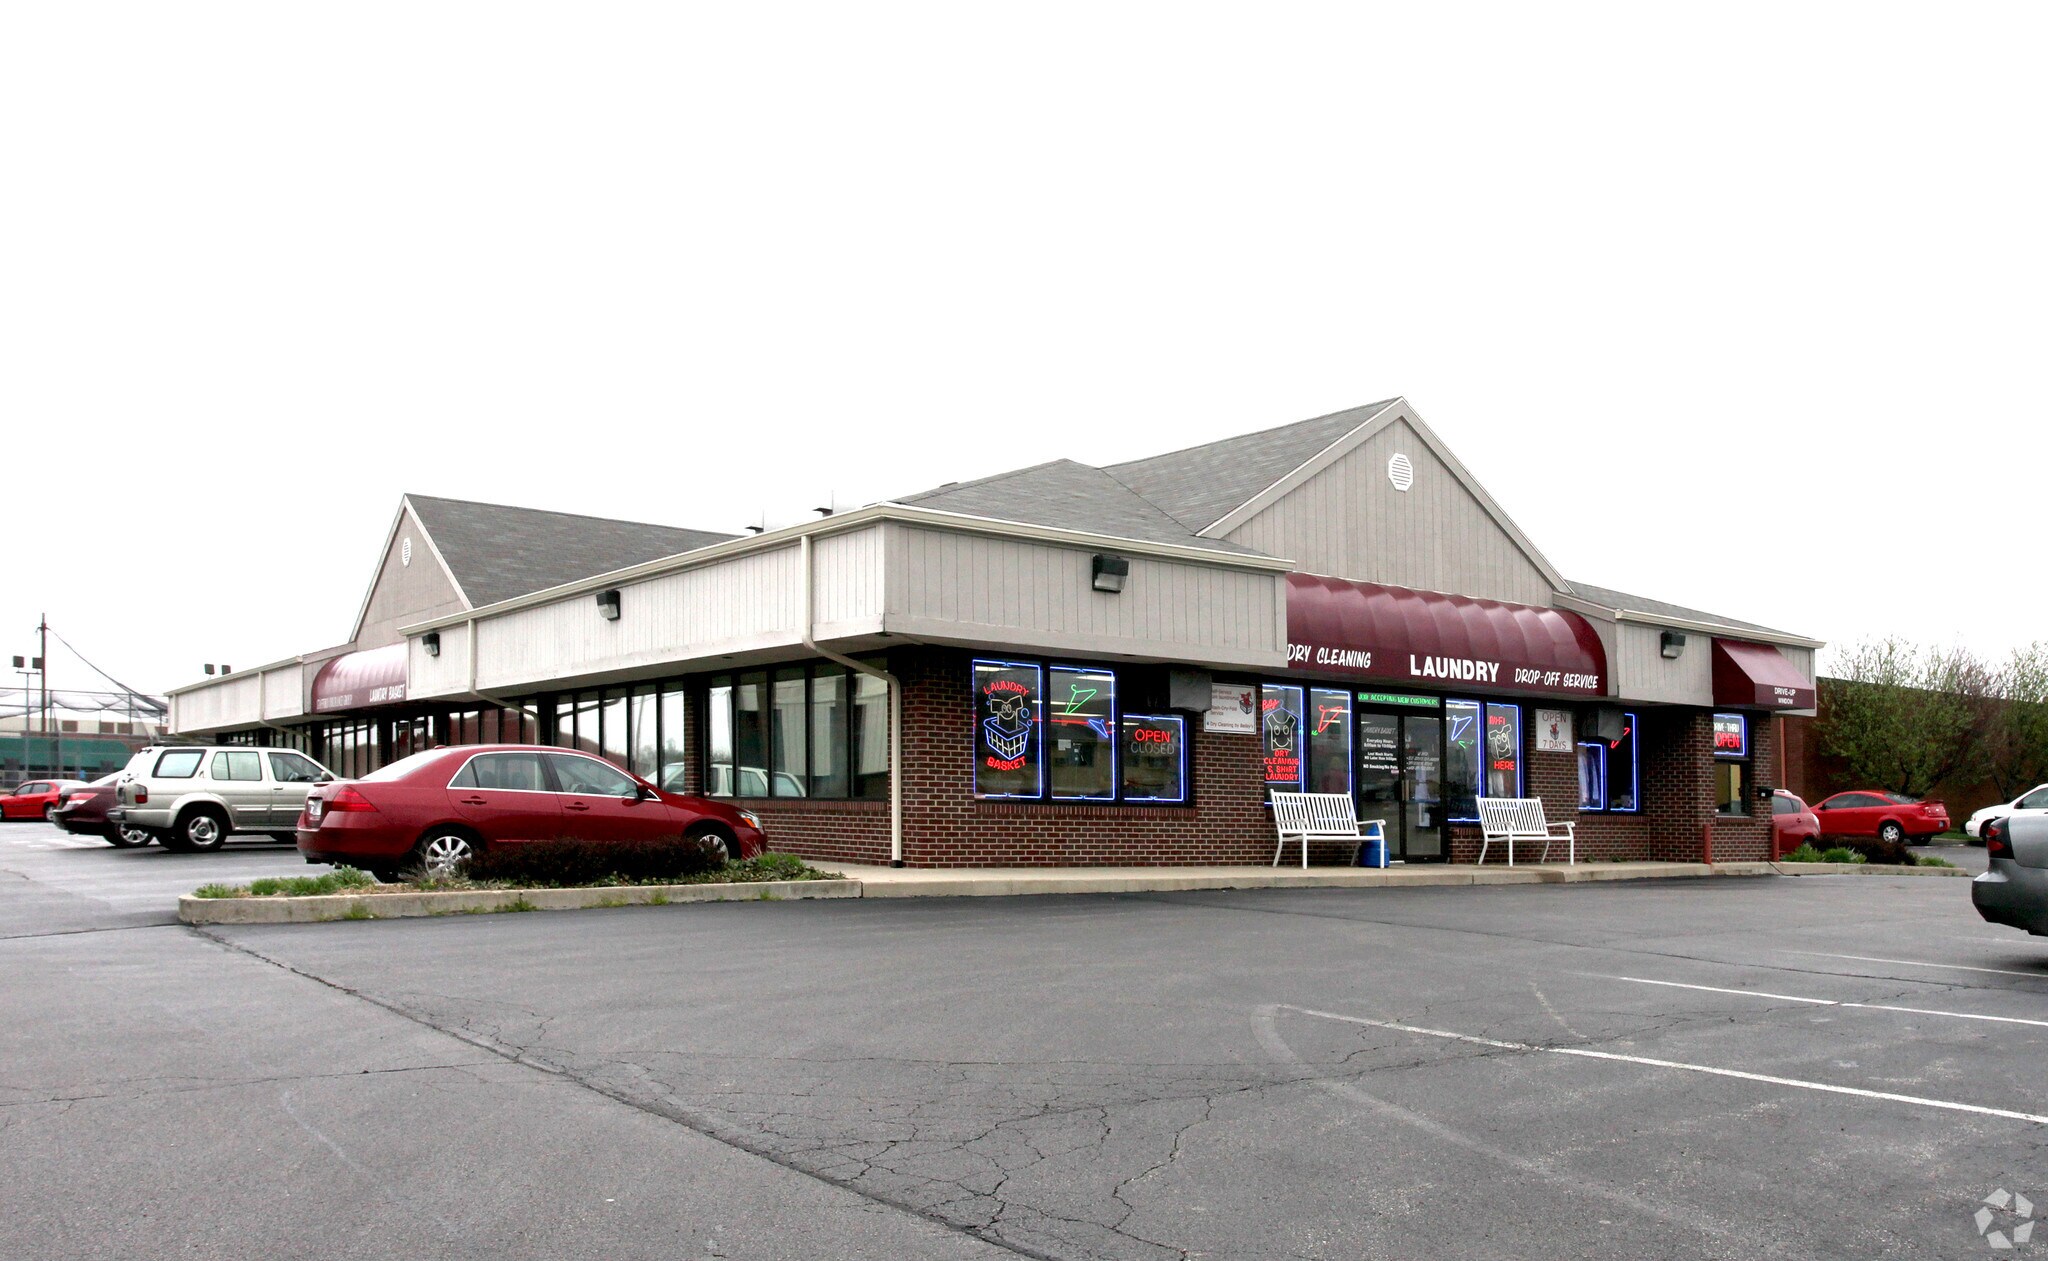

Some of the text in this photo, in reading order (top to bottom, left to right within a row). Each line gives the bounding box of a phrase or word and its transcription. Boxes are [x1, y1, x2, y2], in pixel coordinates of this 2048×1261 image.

[1287, 644, 1371, 668] DRY CLEANING
[1410, 654, 1500, 683] LAUNDRY
[1515, 668, 1598, 690] DROP-OFF SERVICE
[369, 685, 388, 702] LAUNDRY
[388, 684, 405, 701] BASKET
[983, 680, 1030, 697] LAUNDRY
[1774, 687, 1796, 696] DRIVE-UP
[1778, 697, 1793, 705] WINDOW
[1542, 712, 1566, 723] OPEN
[1135, 729, 1171, 743] OPEN
[1715, 732, 1739, 747] OPEN
[1130, 741, 1175, 755] CLOSED
[1543, 740, 1566, 750] 7 DAYS
[987, 755, 1027, 771] BASKET
[1494, 761, 1515, 770] HERE
